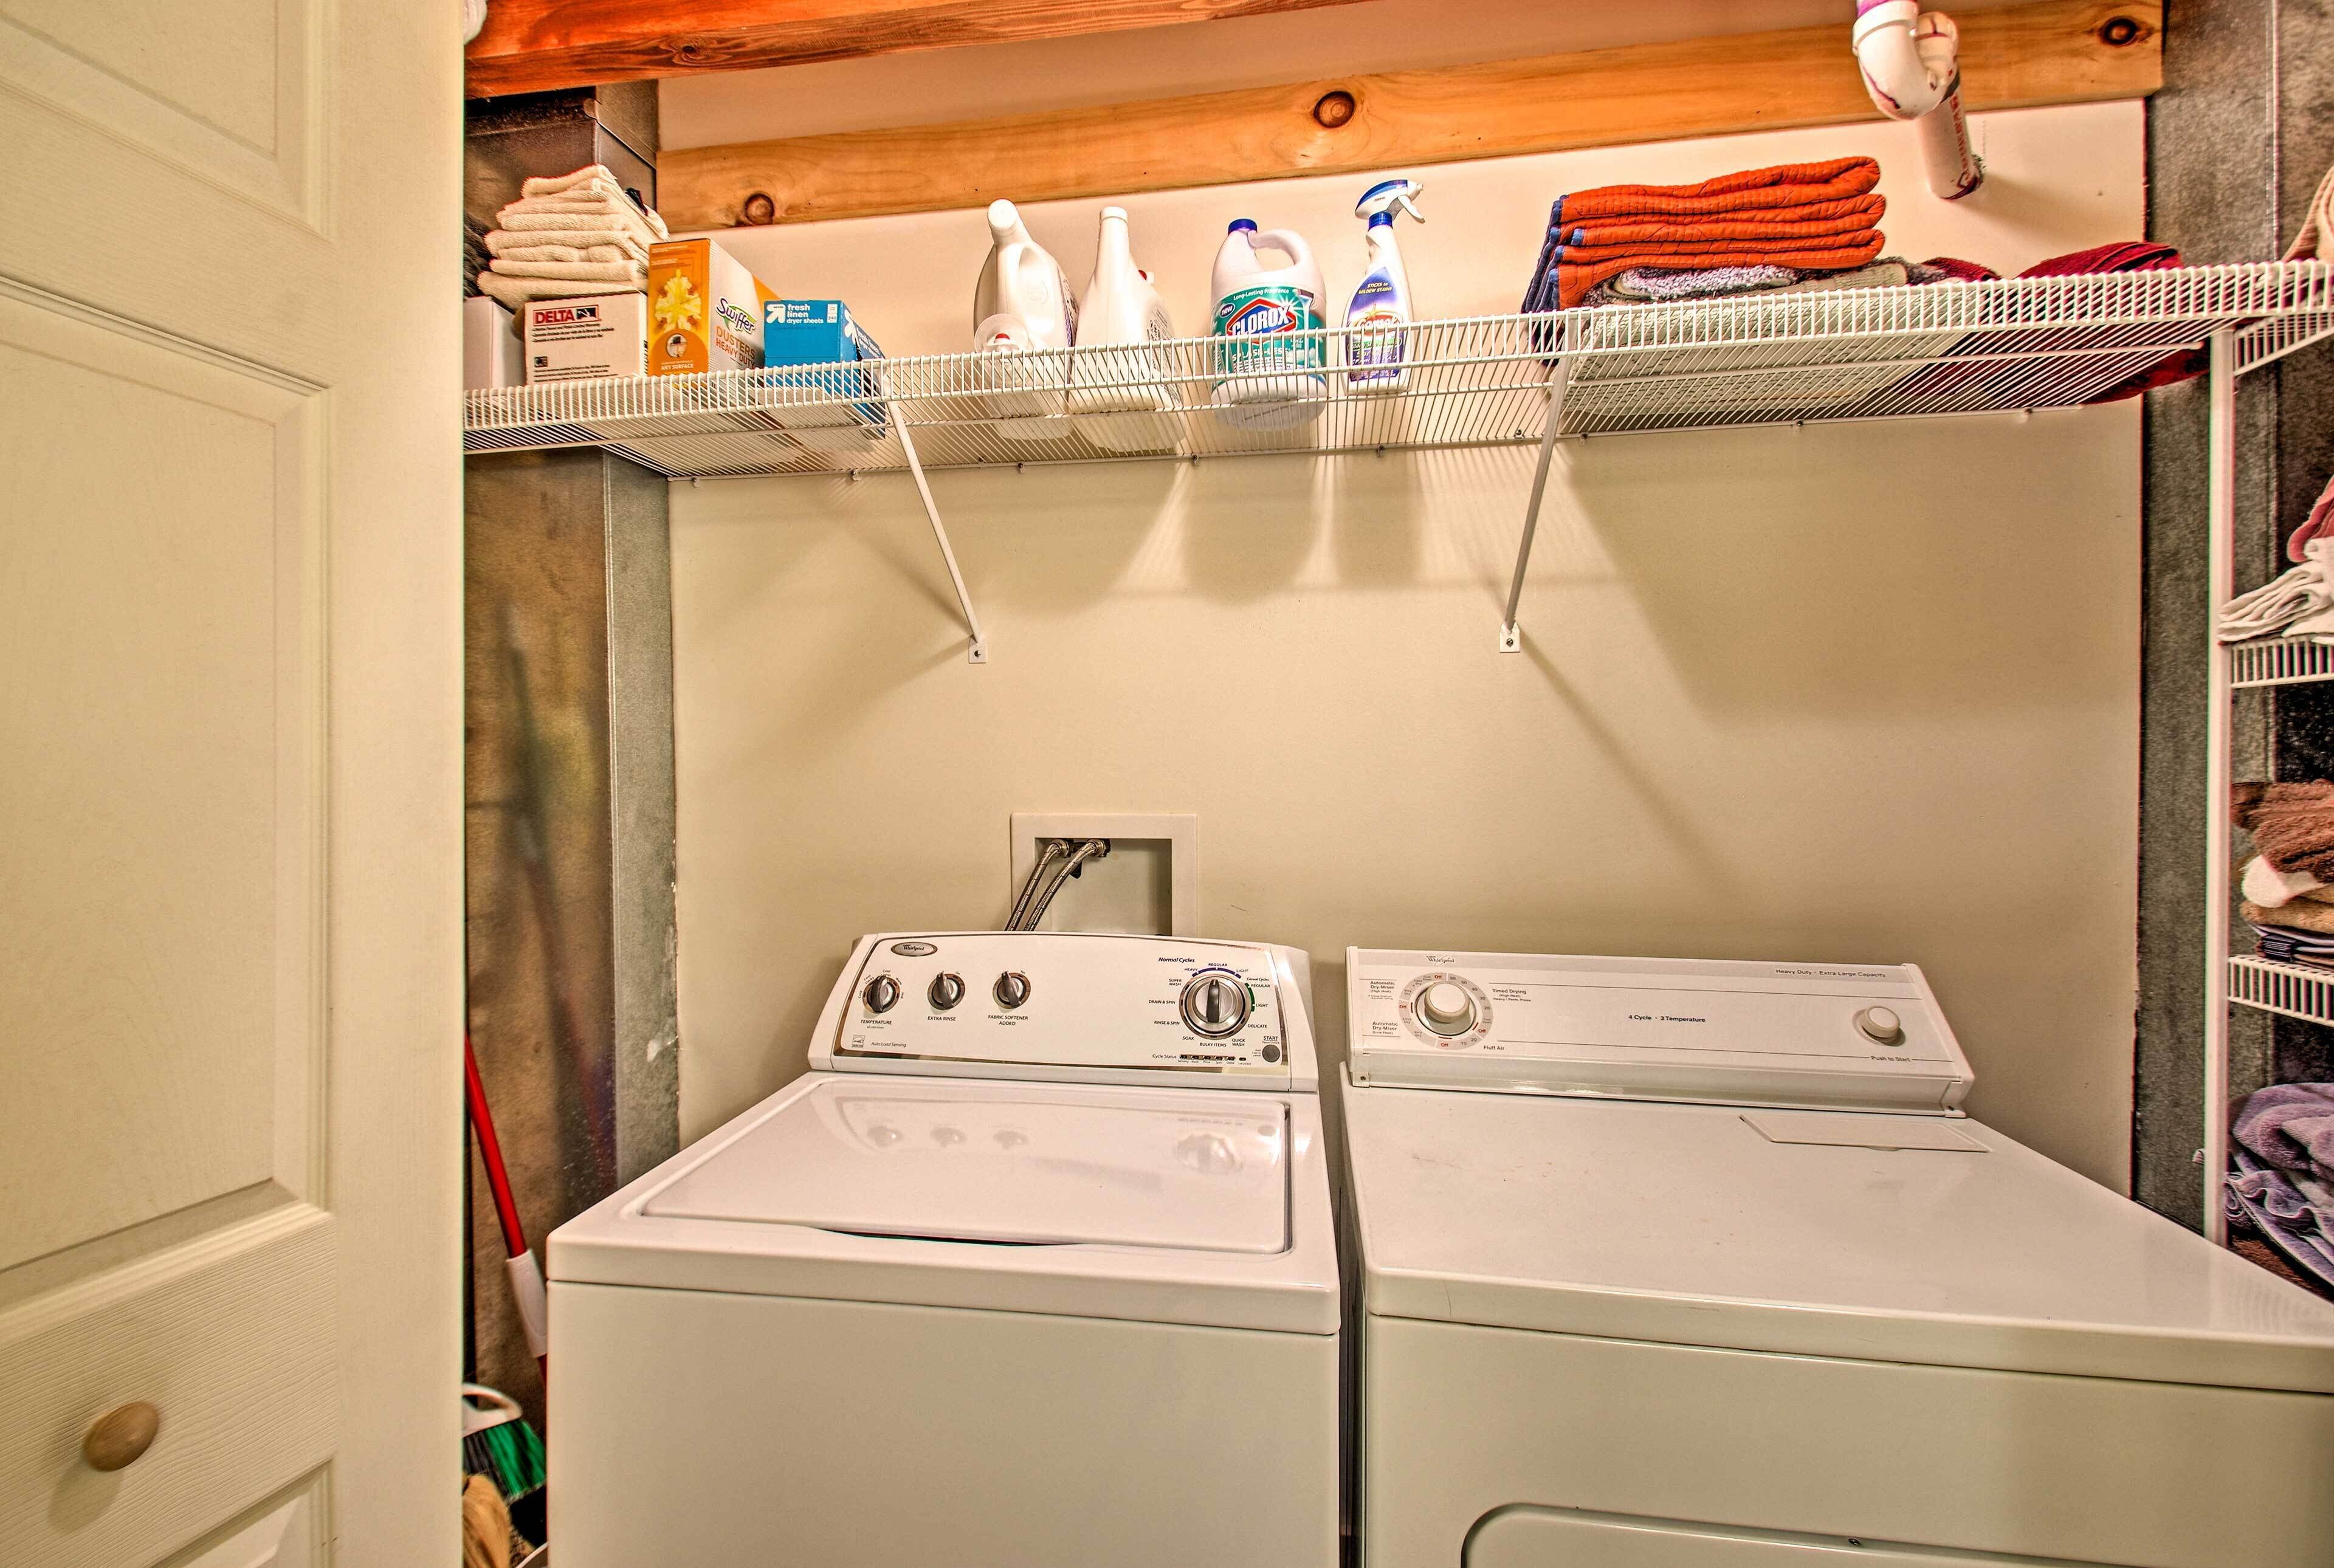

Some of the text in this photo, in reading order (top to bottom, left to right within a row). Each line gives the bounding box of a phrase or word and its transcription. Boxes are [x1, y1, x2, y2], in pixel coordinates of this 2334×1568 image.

[1233, 288, 1264, 301] Long-Lasting
[535, 309, 574, 324] DELTA
[716, 297, 756, 334] Swiffer
[1221, 305, 1233, 316] new
[1232, 305, 1290, 336] CLOROX
[716, 326, 756, 359] DUSTERS
[716, 339, 755, 369] HEAVY DUTY
